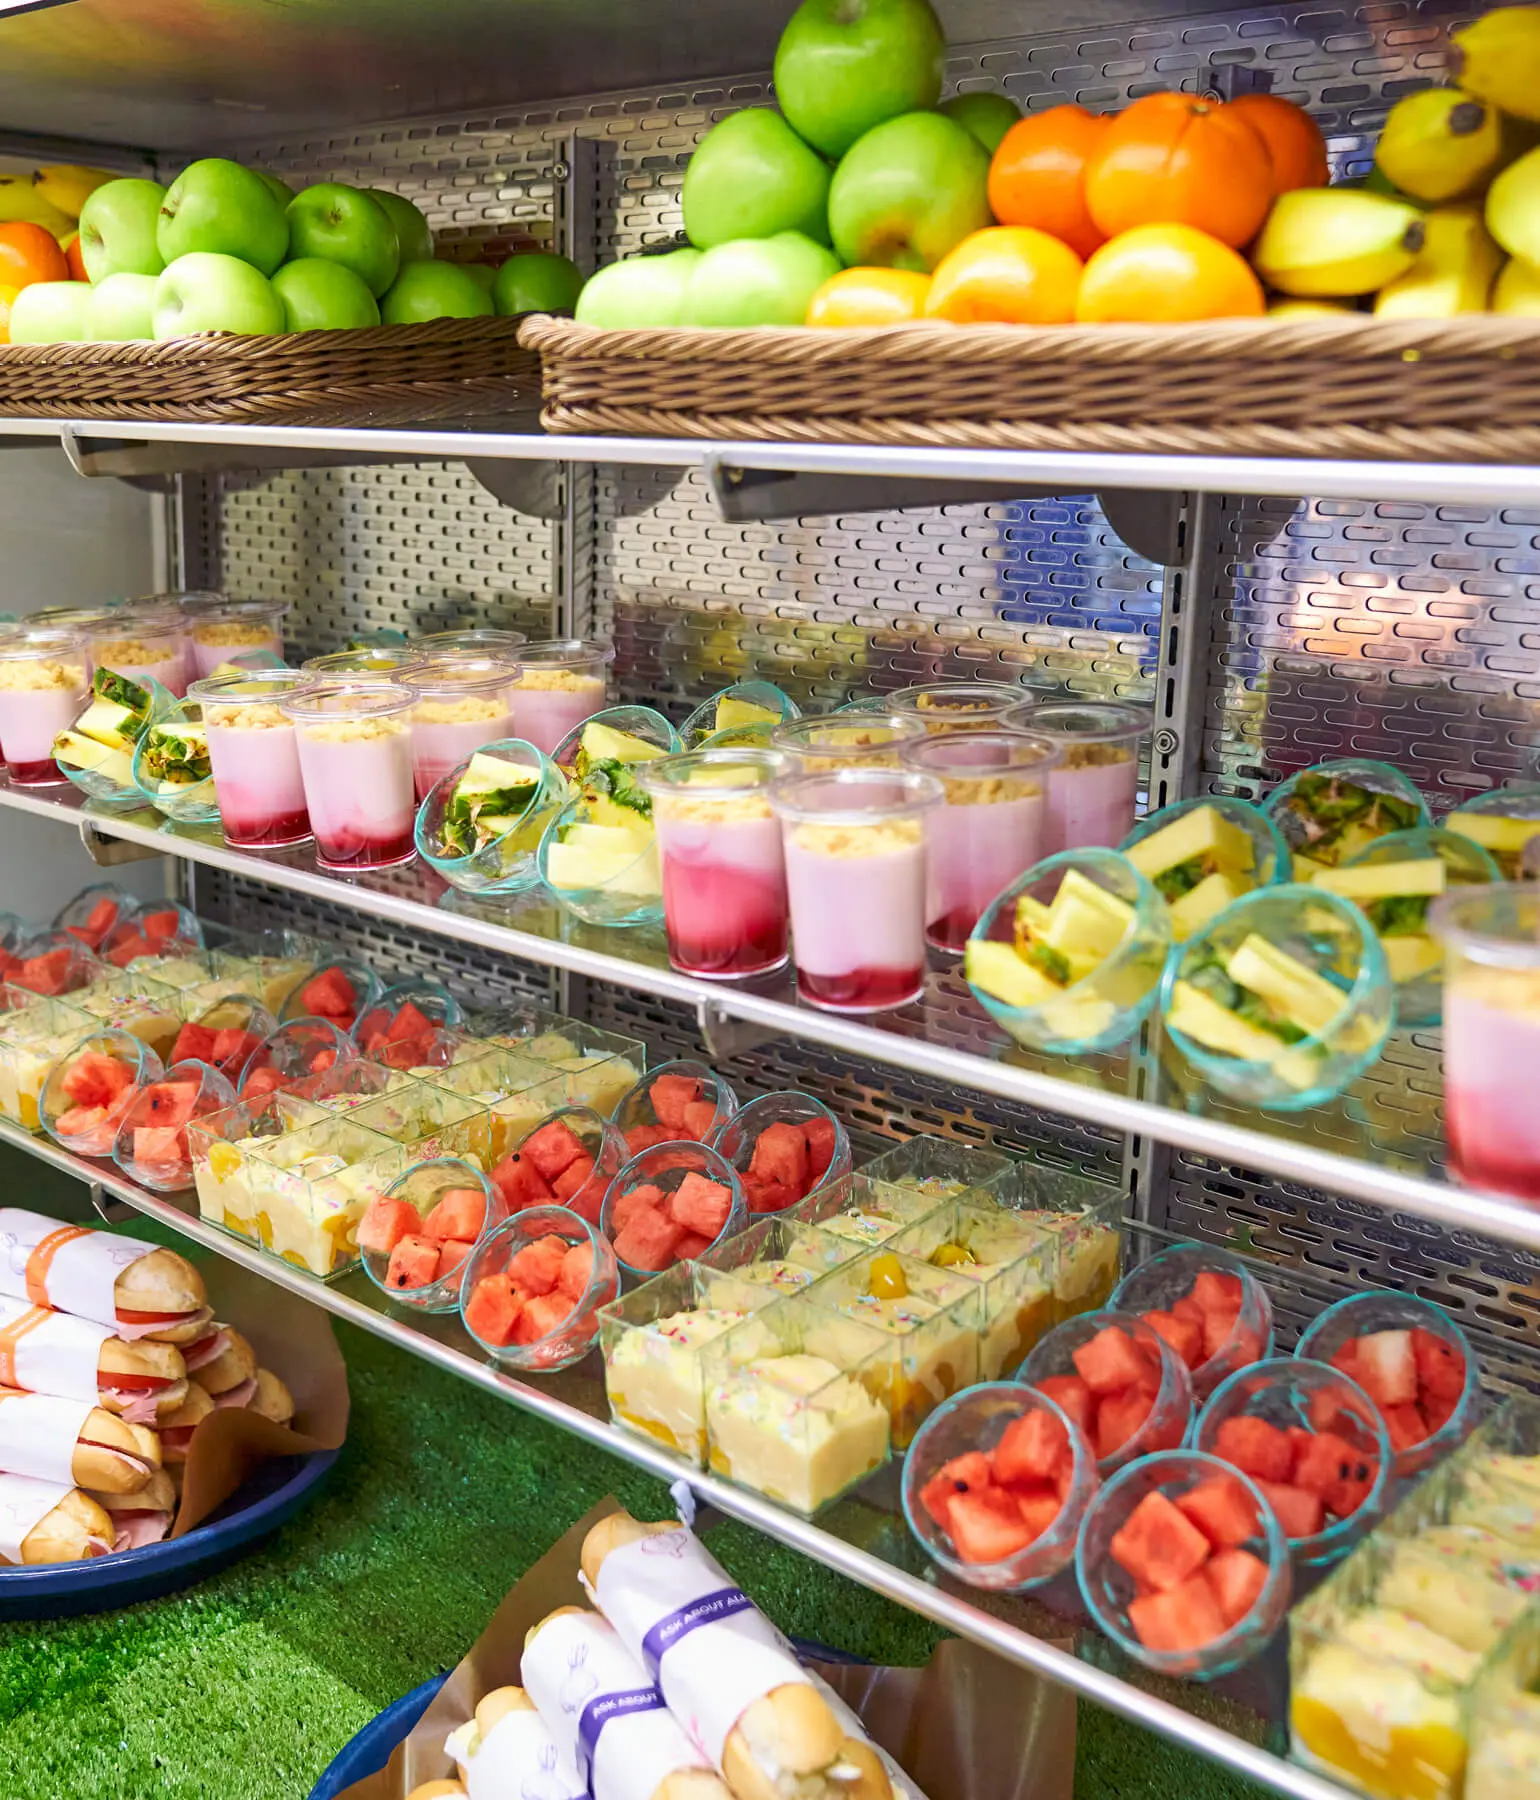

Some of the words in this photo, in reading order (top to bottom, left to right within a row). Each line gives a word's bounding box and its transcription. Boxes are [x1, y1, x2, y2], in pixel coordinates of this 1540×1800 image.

[660, 1620, 683, 1639] ASK
[684, 1600, 724, 1624] ABOUT
[592, 1700, 617, 1719] ASK
[618, 1693, 657, 1707] ABOUT
